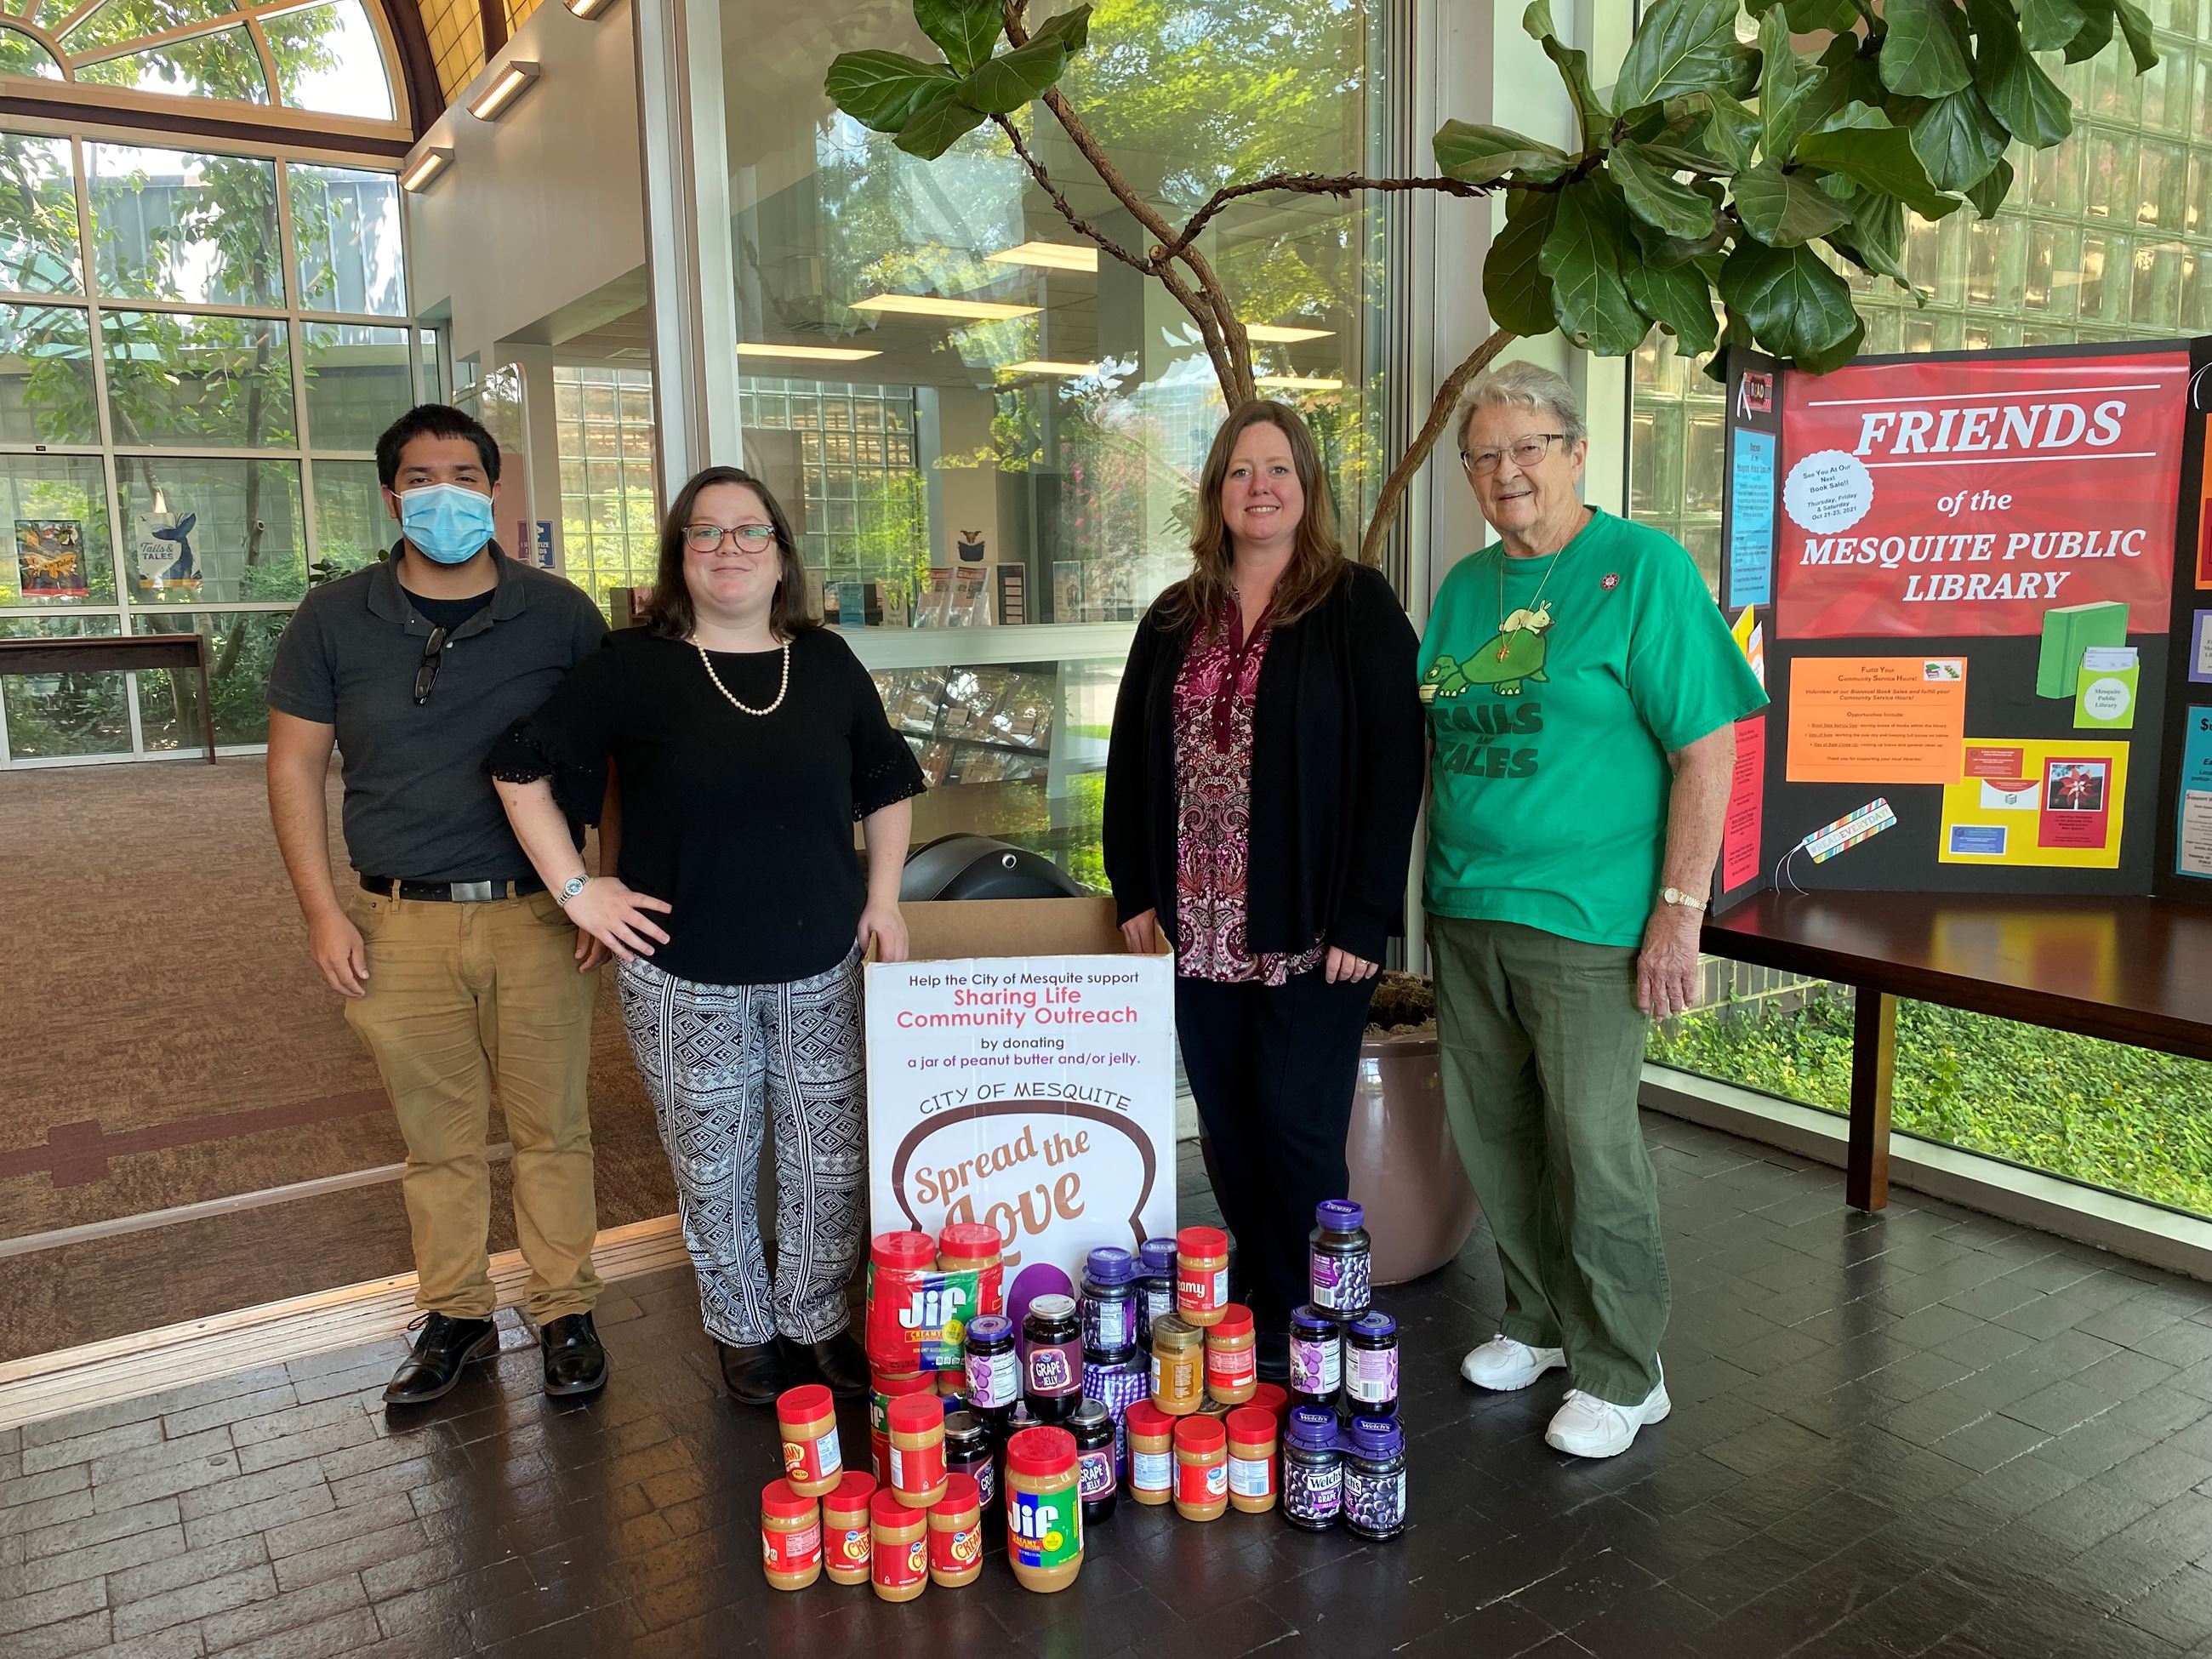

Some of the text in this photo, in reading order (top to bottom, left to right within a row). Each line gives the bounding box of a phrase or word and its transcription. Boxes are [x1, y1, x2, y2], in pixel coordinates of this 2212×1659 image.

[1852, 401, 2127, 457] FRIENDS
[1829, 480, 1849, 489] Sale!!
[1807, 498, 1837, 507] Thursday,
[1823, 502, 1850, 510] Saturday
[1937, 490, 2013, 518] of the
[141, 543, 174, 552] Tails &
[1799, 534, 1997, 568] MESQUITE
[2003, 529, 2146, 561] PUBLIC
[1902, 572, 2072, 602] LIBRARY
[1433, 702, 1543, 734] TAILS
[1433, 741, 1539, 778] TALES
[909, 972, 1140, 989] Help the City of Mesquite support
[954, 987, 1081, 1008] Sharing Life
[897, 1006, 1138, 1029] Community Outreach
[980, 1037, 1065, 1052] by donating
[908, 1052, 1141, 1069] a jar of peanut butter and/or jelly.
[920, 1081, 1132, 1115] CITY OF MESQUITE
[915, 1125, 1091, 1206] Spread the
[898, 1287, 966, 1329] Jif
[909, 1330, 942, 1338] CREAMY
[1035, 1361, 1062, 1377] GRAPE
[1043, 1376, 1058, 1386] JELLY
[1362, 1422, 1391, 1430] Welch's
[1086, 1479, 1101, 1491] JELLY
[1318, 1492, 1337, 1503] GRAPE
[1007, 1501, 1059, 1538] Jif
